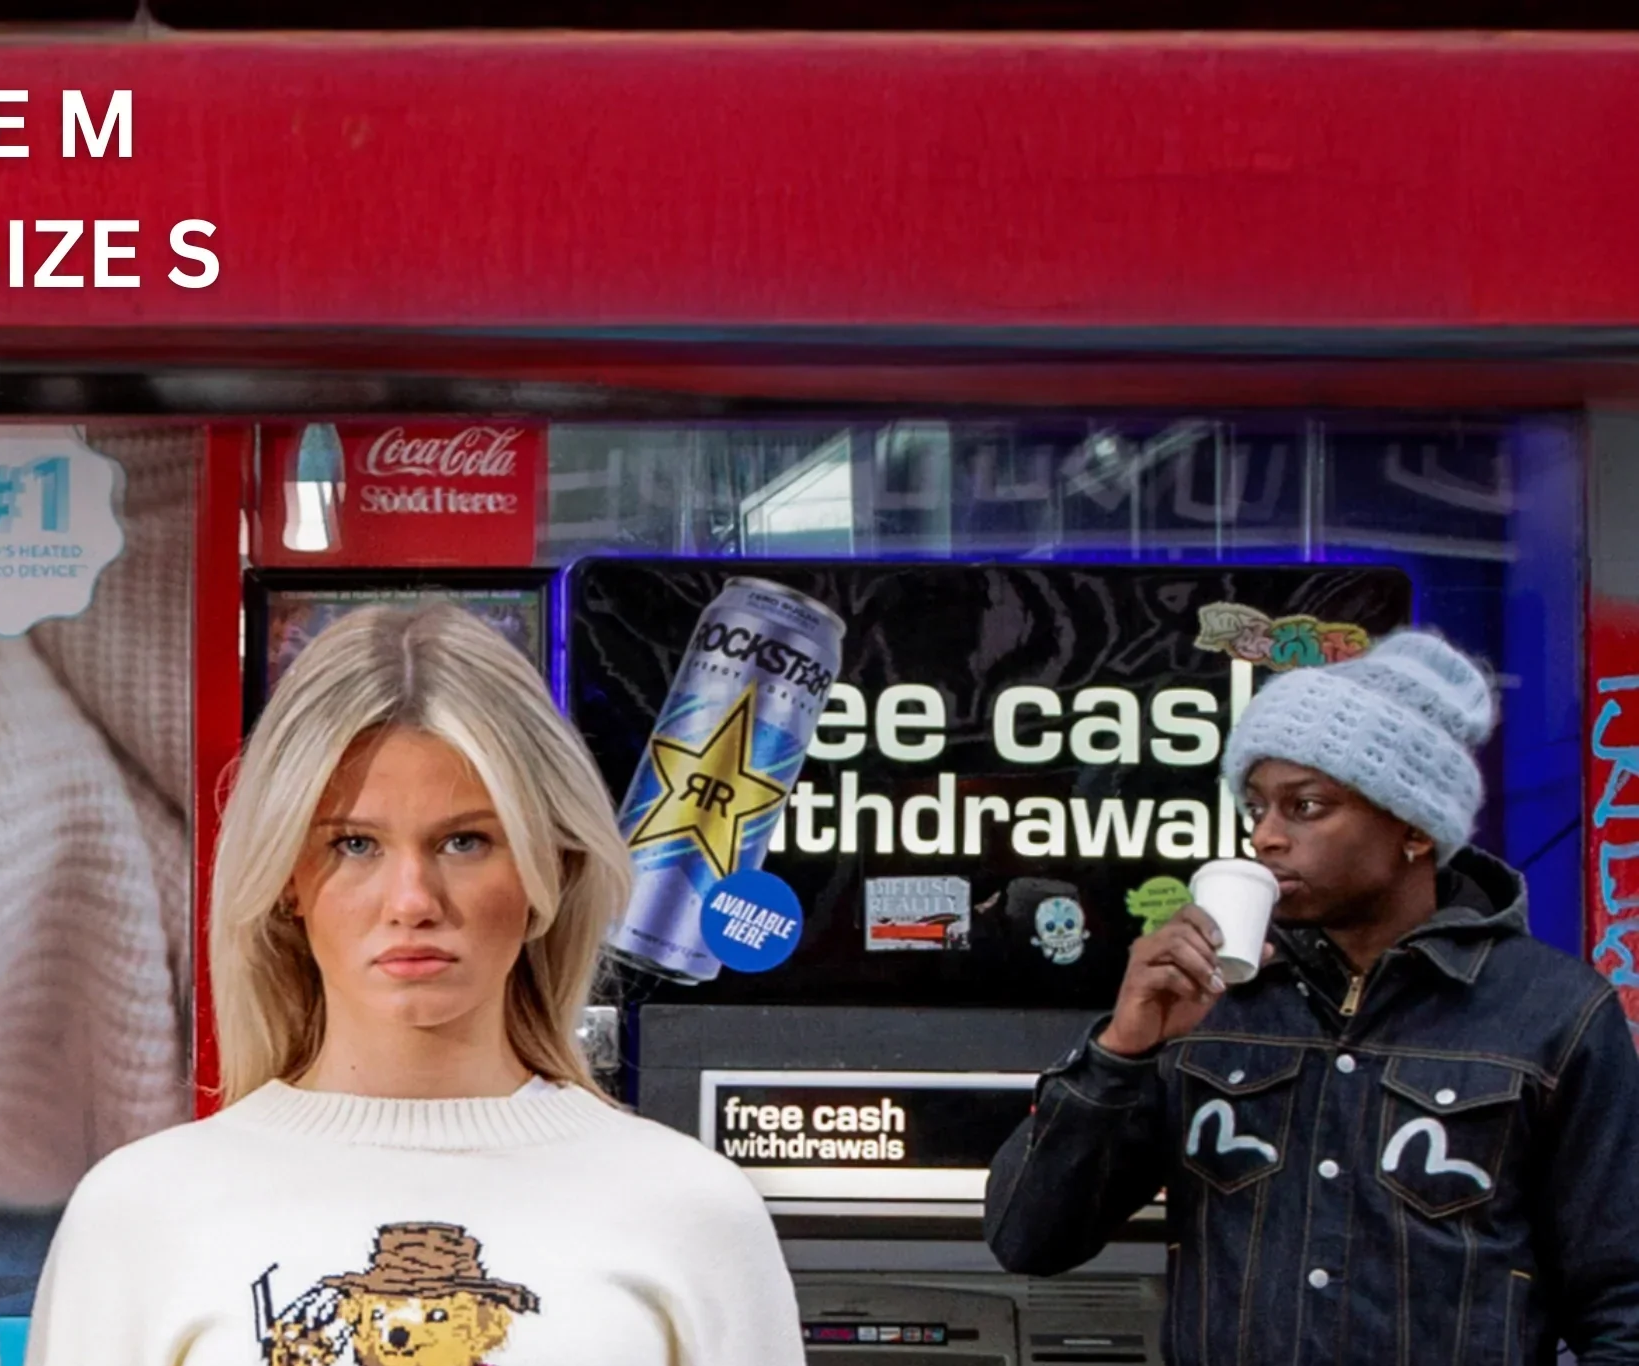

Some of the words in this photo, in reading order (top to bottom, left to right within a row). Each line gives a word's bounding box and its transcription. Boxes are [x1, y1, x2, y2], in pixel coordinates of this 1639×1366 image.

[365, 426, 524, 477] Coca-Cola
[19, 544, 83, 558] HEATED
[806, 680, 948, 762] ee
[769, 771, 1259, 859] thdrawal
[710, 891, 797, 939] AVAILABLE
[722, 917, 769, 950] HERE
[724, 1096, 803, 1131] free
[812, 1097, 905, 1132] cash
[724, 1132, 905, 1160] withdrawals
